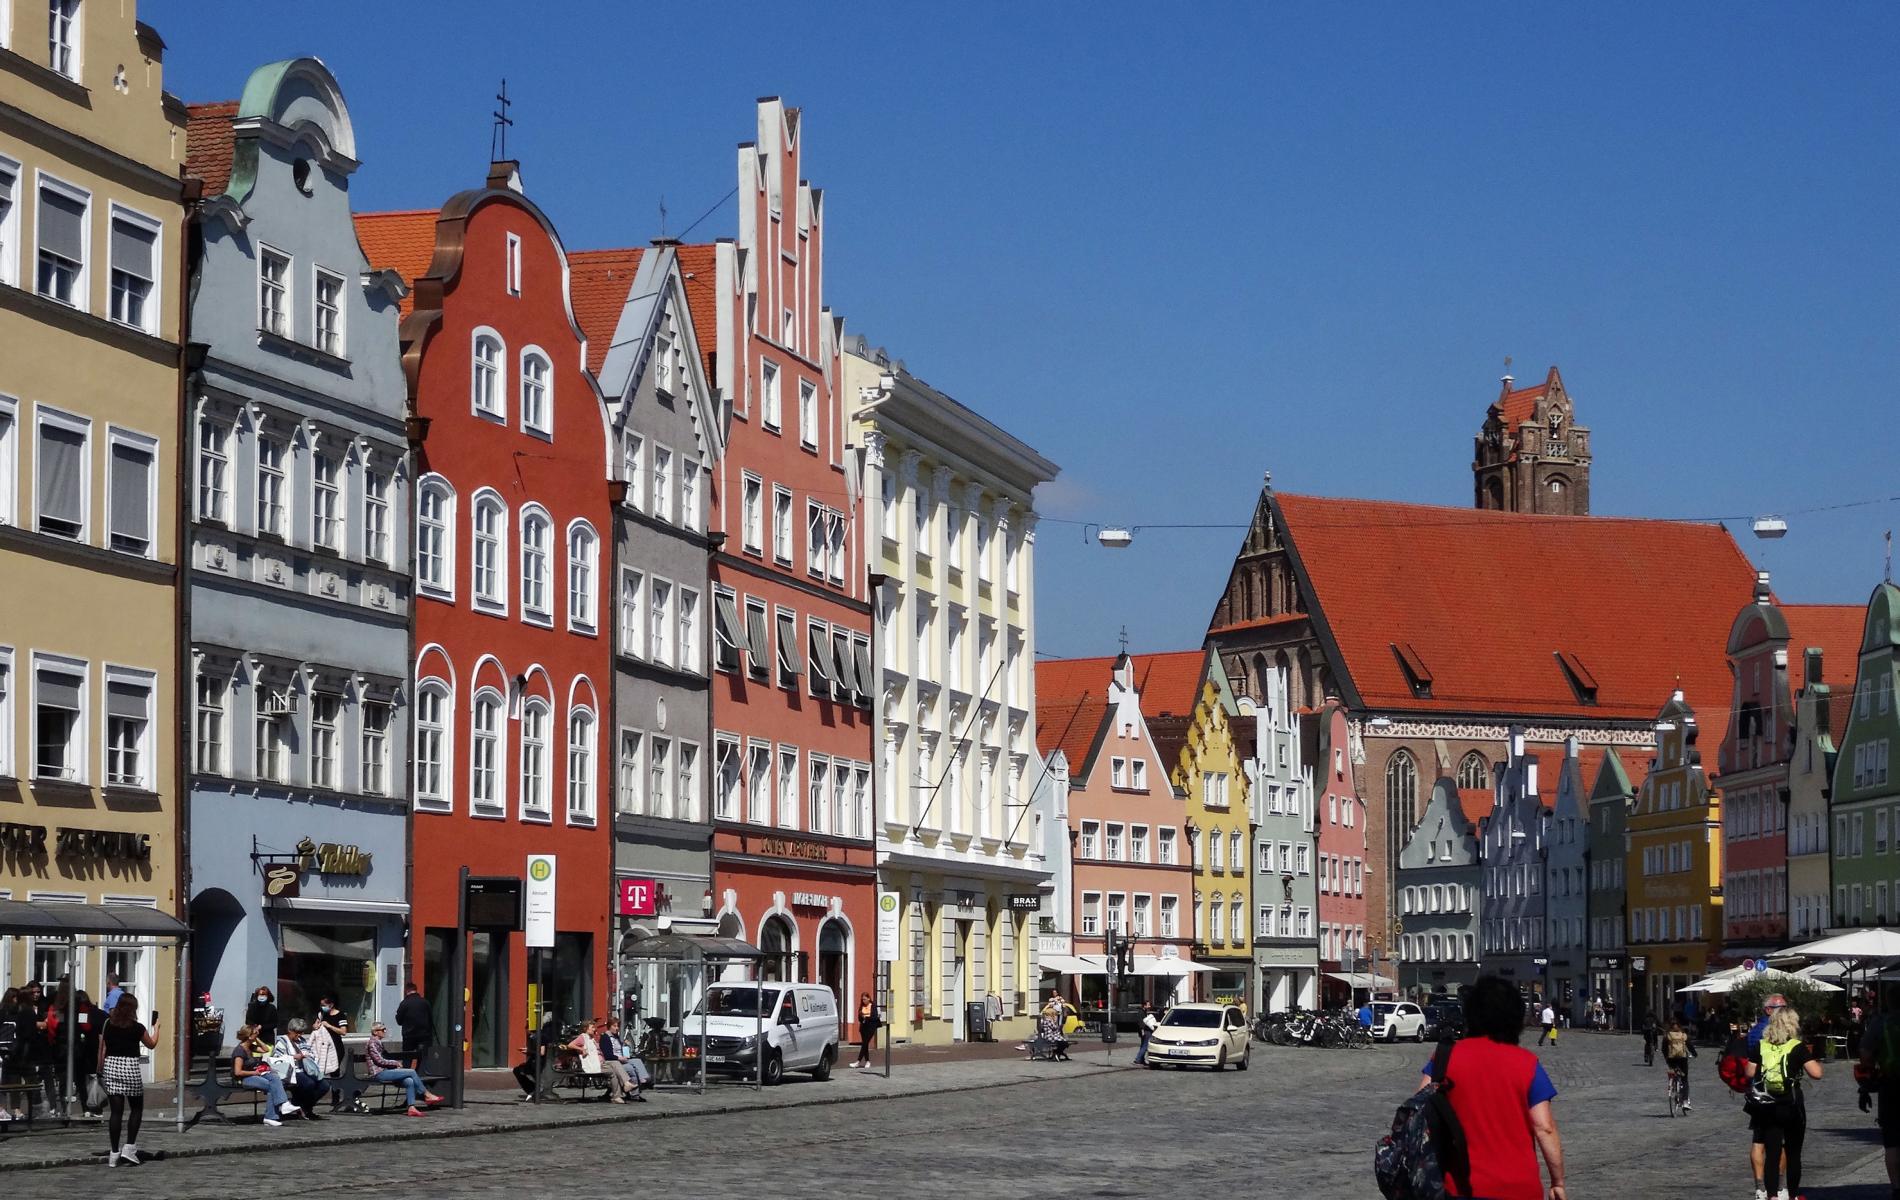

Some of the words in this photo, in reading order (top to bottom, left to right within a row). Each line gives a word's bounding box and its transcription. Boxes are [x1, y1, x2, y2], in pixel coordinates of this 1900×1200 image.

[55, 827, 152, 861] ZEITUNG
[317, 843, 373, 874] Tchibo
[627, 885, 647, 909] T
